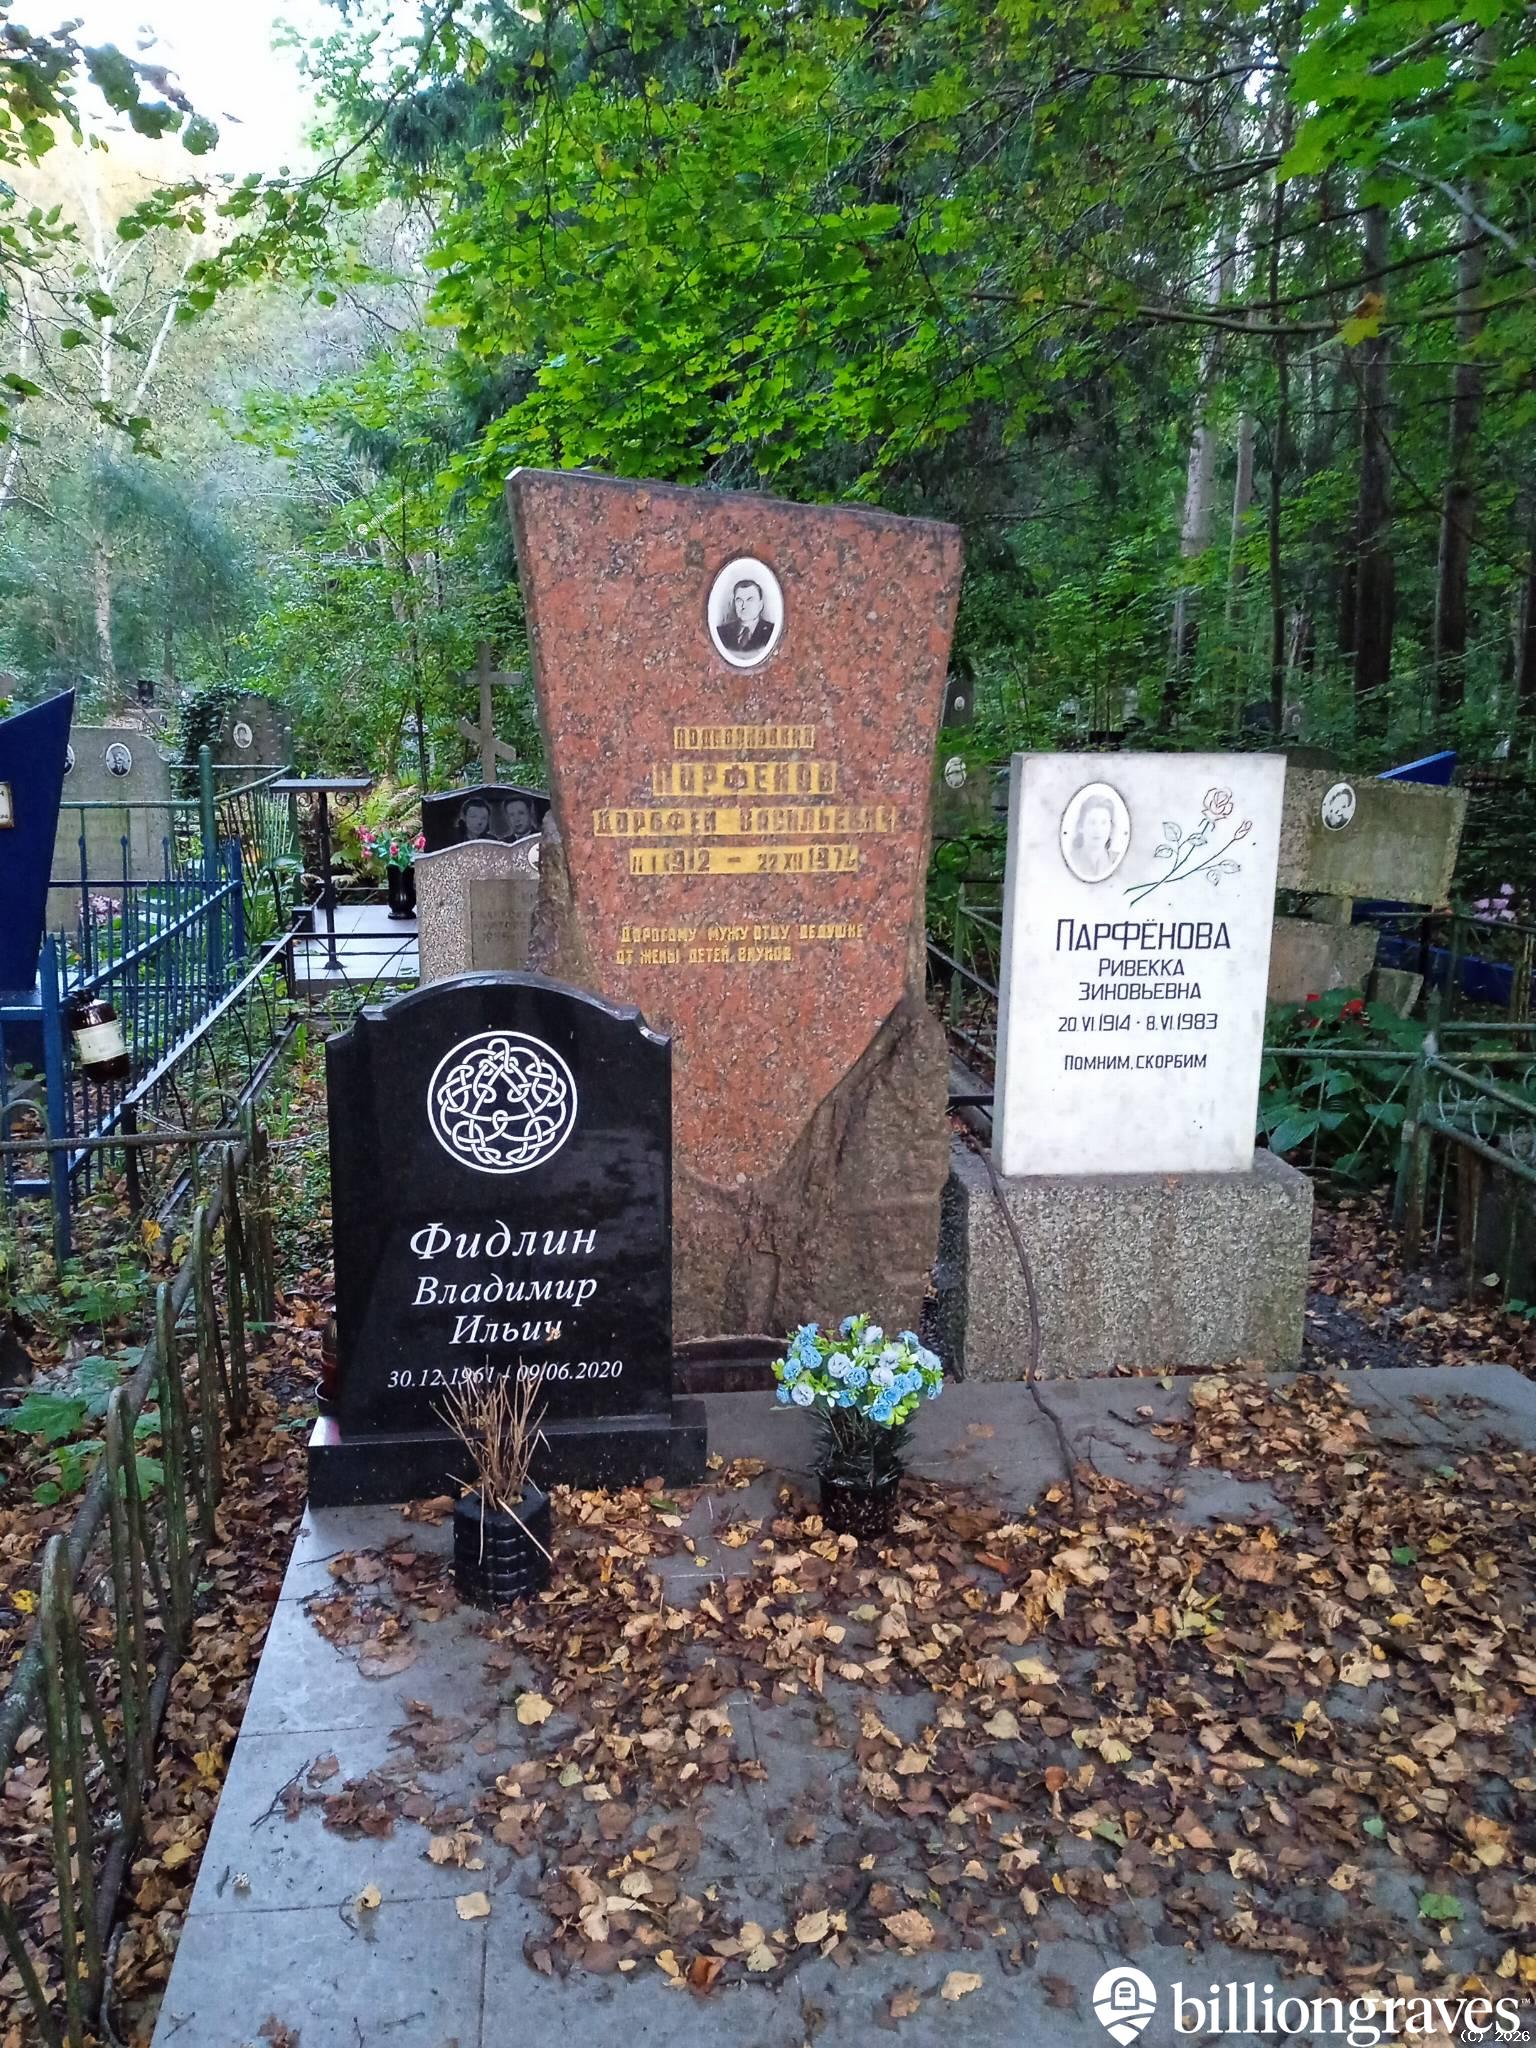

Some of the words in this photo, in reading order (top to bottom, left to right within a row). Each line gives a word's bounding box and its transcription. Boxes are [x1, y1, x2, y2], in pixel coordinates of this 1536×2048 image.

[654, 763, 835, 794] ПАРФЕНОВ
[757, 853, 778, 871] 22
[621, 926, 697, 943] ДОРОГОМУ
[708, 925, 749, 941] МУЖУ
[753, 925, 790, 940] ОТЦУ
[800, 923, 864, 940] ДЕДУШКЕ
[1055, 917, 1231, 951] ПАРФЁНОВА
[616, 949, 634, 965] ОТ
[640, 948, 679, 964] ЖЕНЫ
[688, 945, 730, 963] ДЕТЕЙ
[1098, 957, 1185, 977] РИВЕККА
[1078, 981, 1202, 1001] ЗИНОВЬЕВНА
[410, 1219, 597, 1260] Фидлин
[412, 1272, 598, 1307] Владимир
[517, 1360, 623, 1382] 0906.2020
